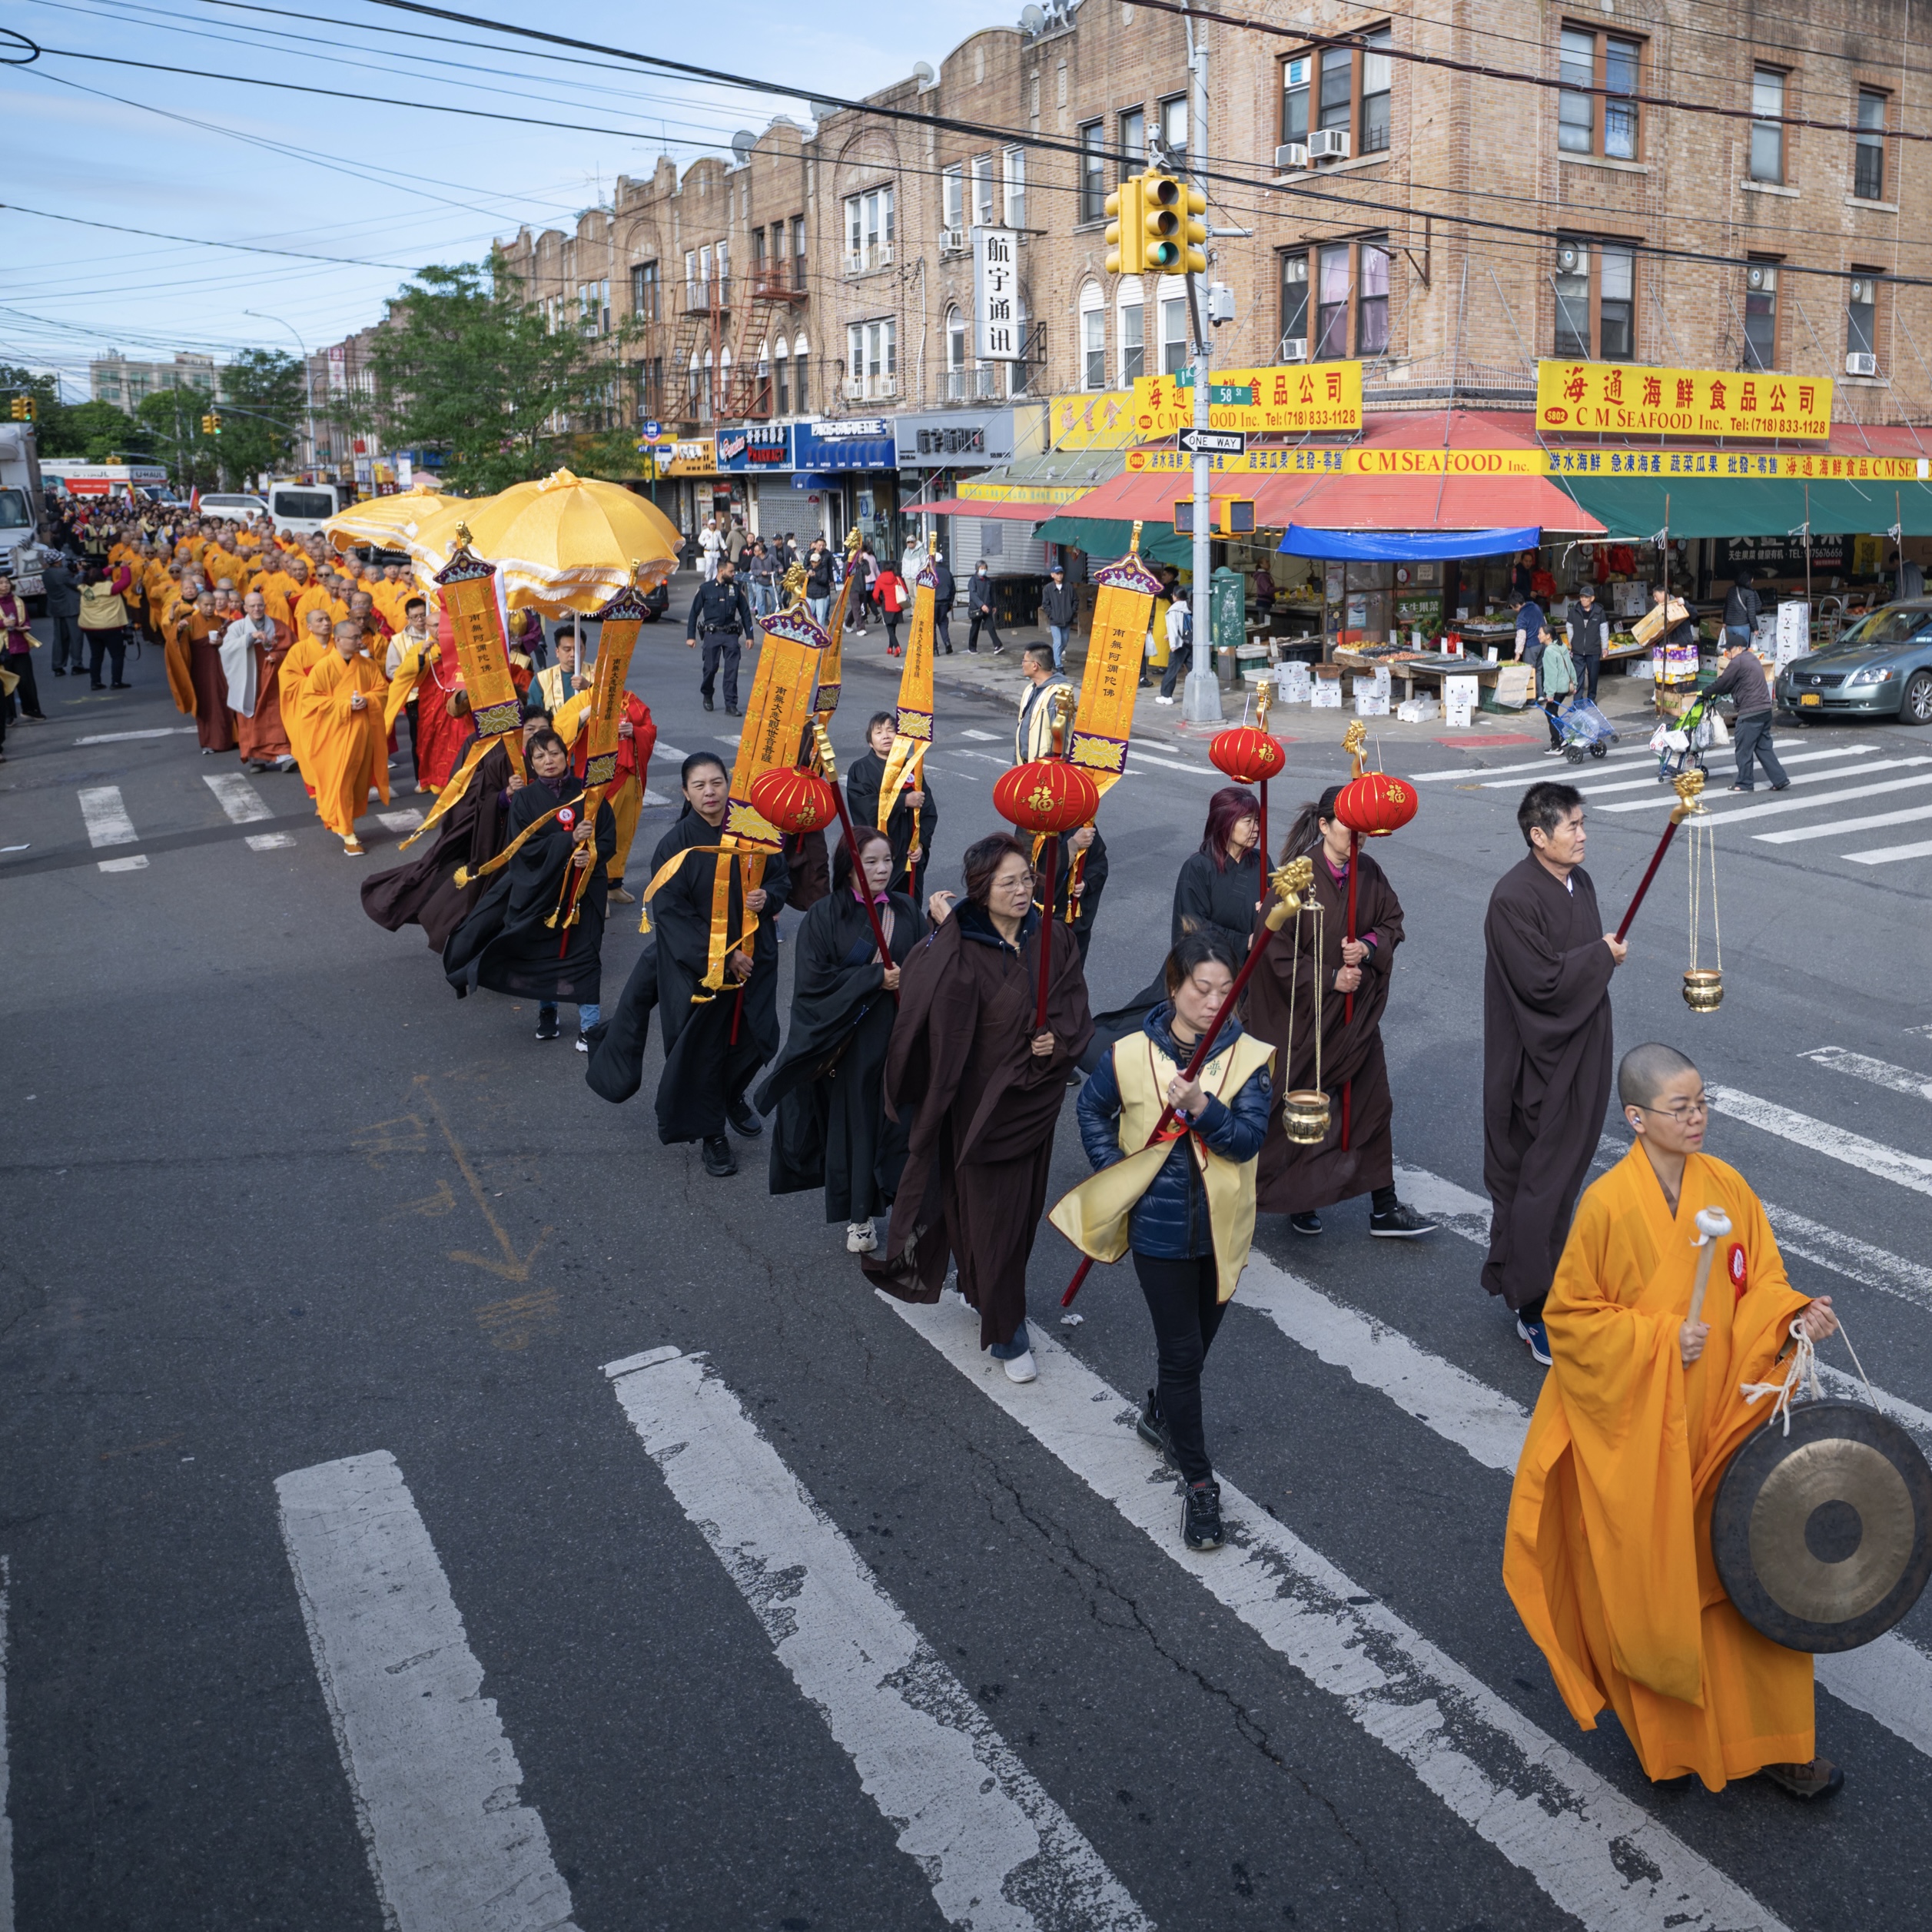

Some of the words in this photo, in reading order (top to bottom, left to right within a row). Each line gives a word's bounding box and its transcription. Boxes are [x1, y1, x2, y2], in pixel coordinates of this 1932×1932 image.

[988, 237, 1011, 352] 航宇通讯
[1181, 370, 1186, 385] 8
[1220, 387, 1233, 403] 58
[1236, 387, 1242, 397] St
[1563, 367, 1815, 415] 海通海鮮食品公司
[1157, 413, 1165, 430] C
[1169, 413, 1178, 430] M
[1241, 412, 1260, 427] Inc.
[1547, 411, 1565, 421] 5802
[1576, 407, 1588, 426] C
[1595, 408, 1610, 427] M
[1617, 409, 1693, 430] SEAFOOD
[1699, 415, 1723, 431] Inc.
[1189, 436, 1208, 446] ONE
[1217, 437, 1237, 448] WAY
[747, 446, 785, 463] PHARMACY
[1358, 452, 1373, 471] C
[1378, 452, 1397, 471] M
[1402, 451, 1502, 472] SEAFOOD
[1508, 460, 1529, 472] Inc.
[1549, 453, 1602, 472] 游水海鮮
[1611, 453, 1661, 473] 急凍海產
[1670, 454, 1718, 473] 蔬菜瓜果
[468, 613, 493, 673] 南無阿彌陀佛
[1103, 628, 1125, 698] 南無阿彌陀佛
[762, 685, 787, 764] 南無大悲觀世音菩薩
[1259, 743, 1275, 762] 福
[1027, 786, 1055, 812] 福
[1386, 785, 1406, 803] 福
[796, 806, 817, 827] 福
